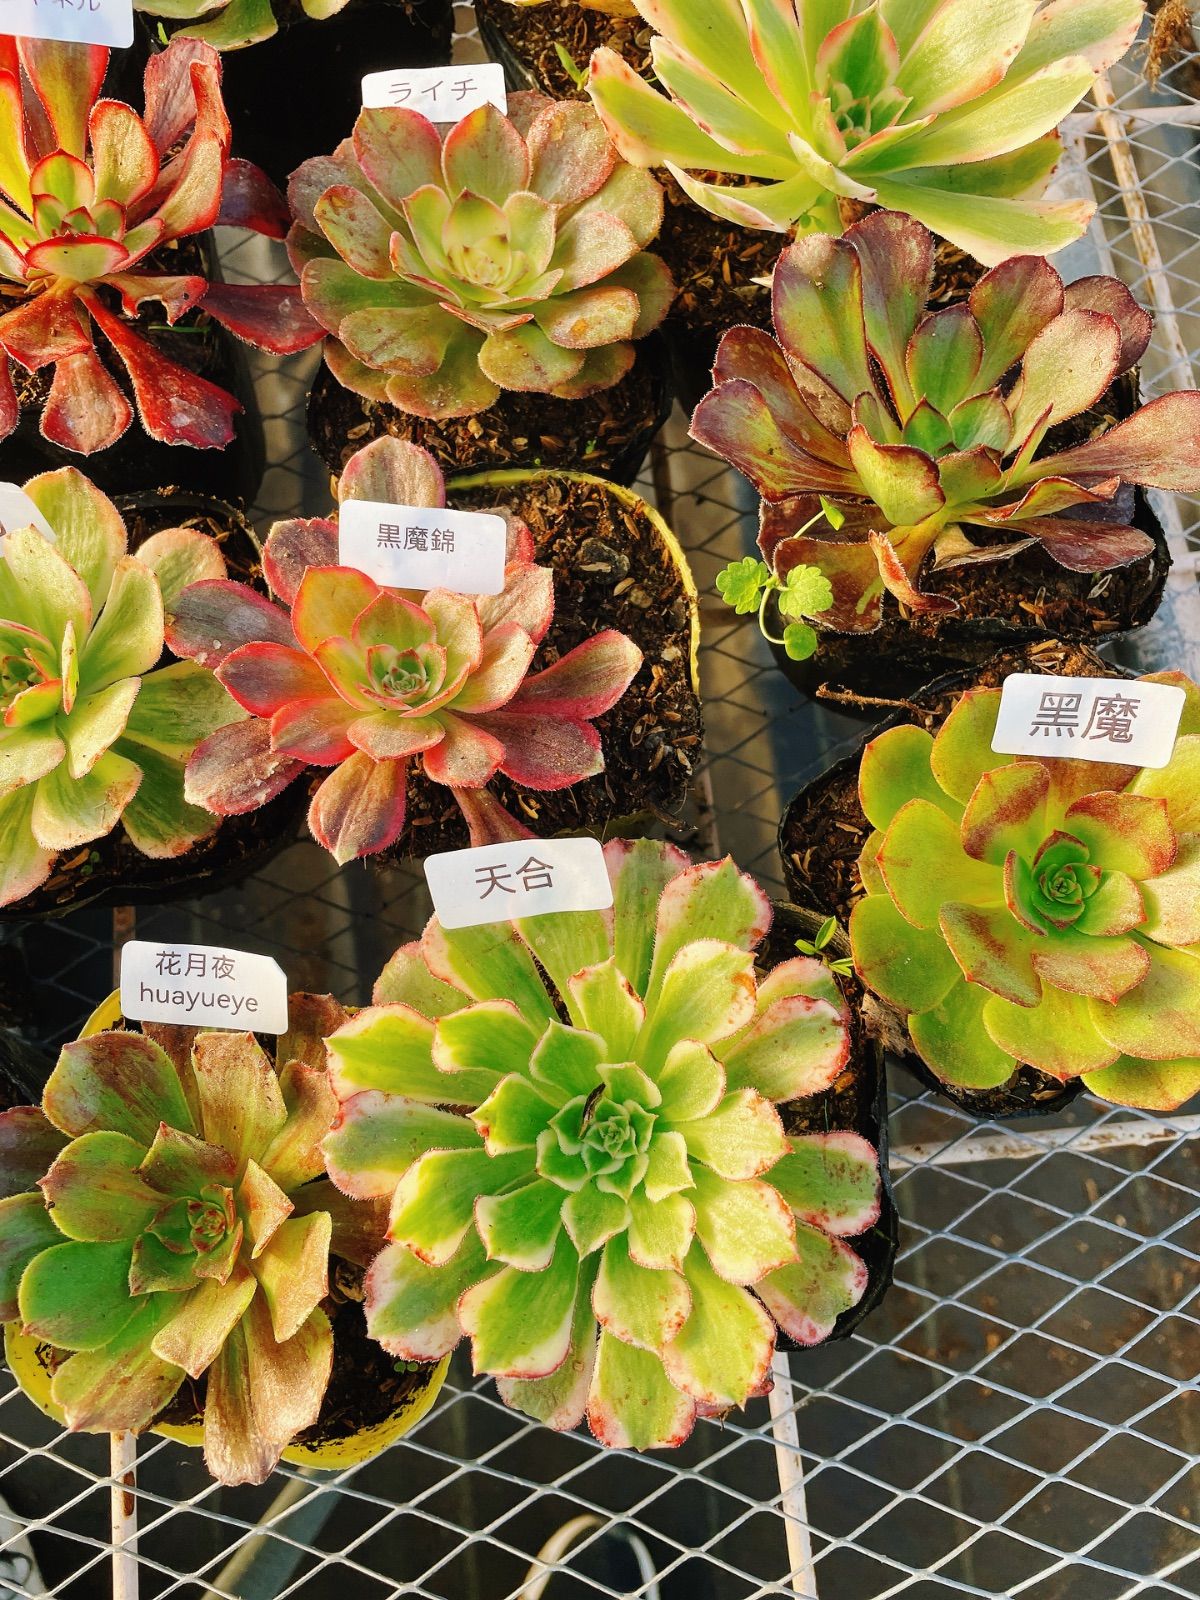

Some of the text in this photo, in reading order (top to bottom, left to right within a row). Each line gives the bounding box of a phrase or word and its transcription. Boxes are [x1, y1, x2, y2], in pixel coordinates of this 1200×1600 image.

[388, 78, 478, 104] ライチ
[377, 523, 455, 554] 黒魔錦
[1028, 692, 1141, 743] 黑魔
[474, 856, 554, 899] 天合
[155, 950, 236, 981] 花月夜
[140, 981, 259, 1015] huayueye
